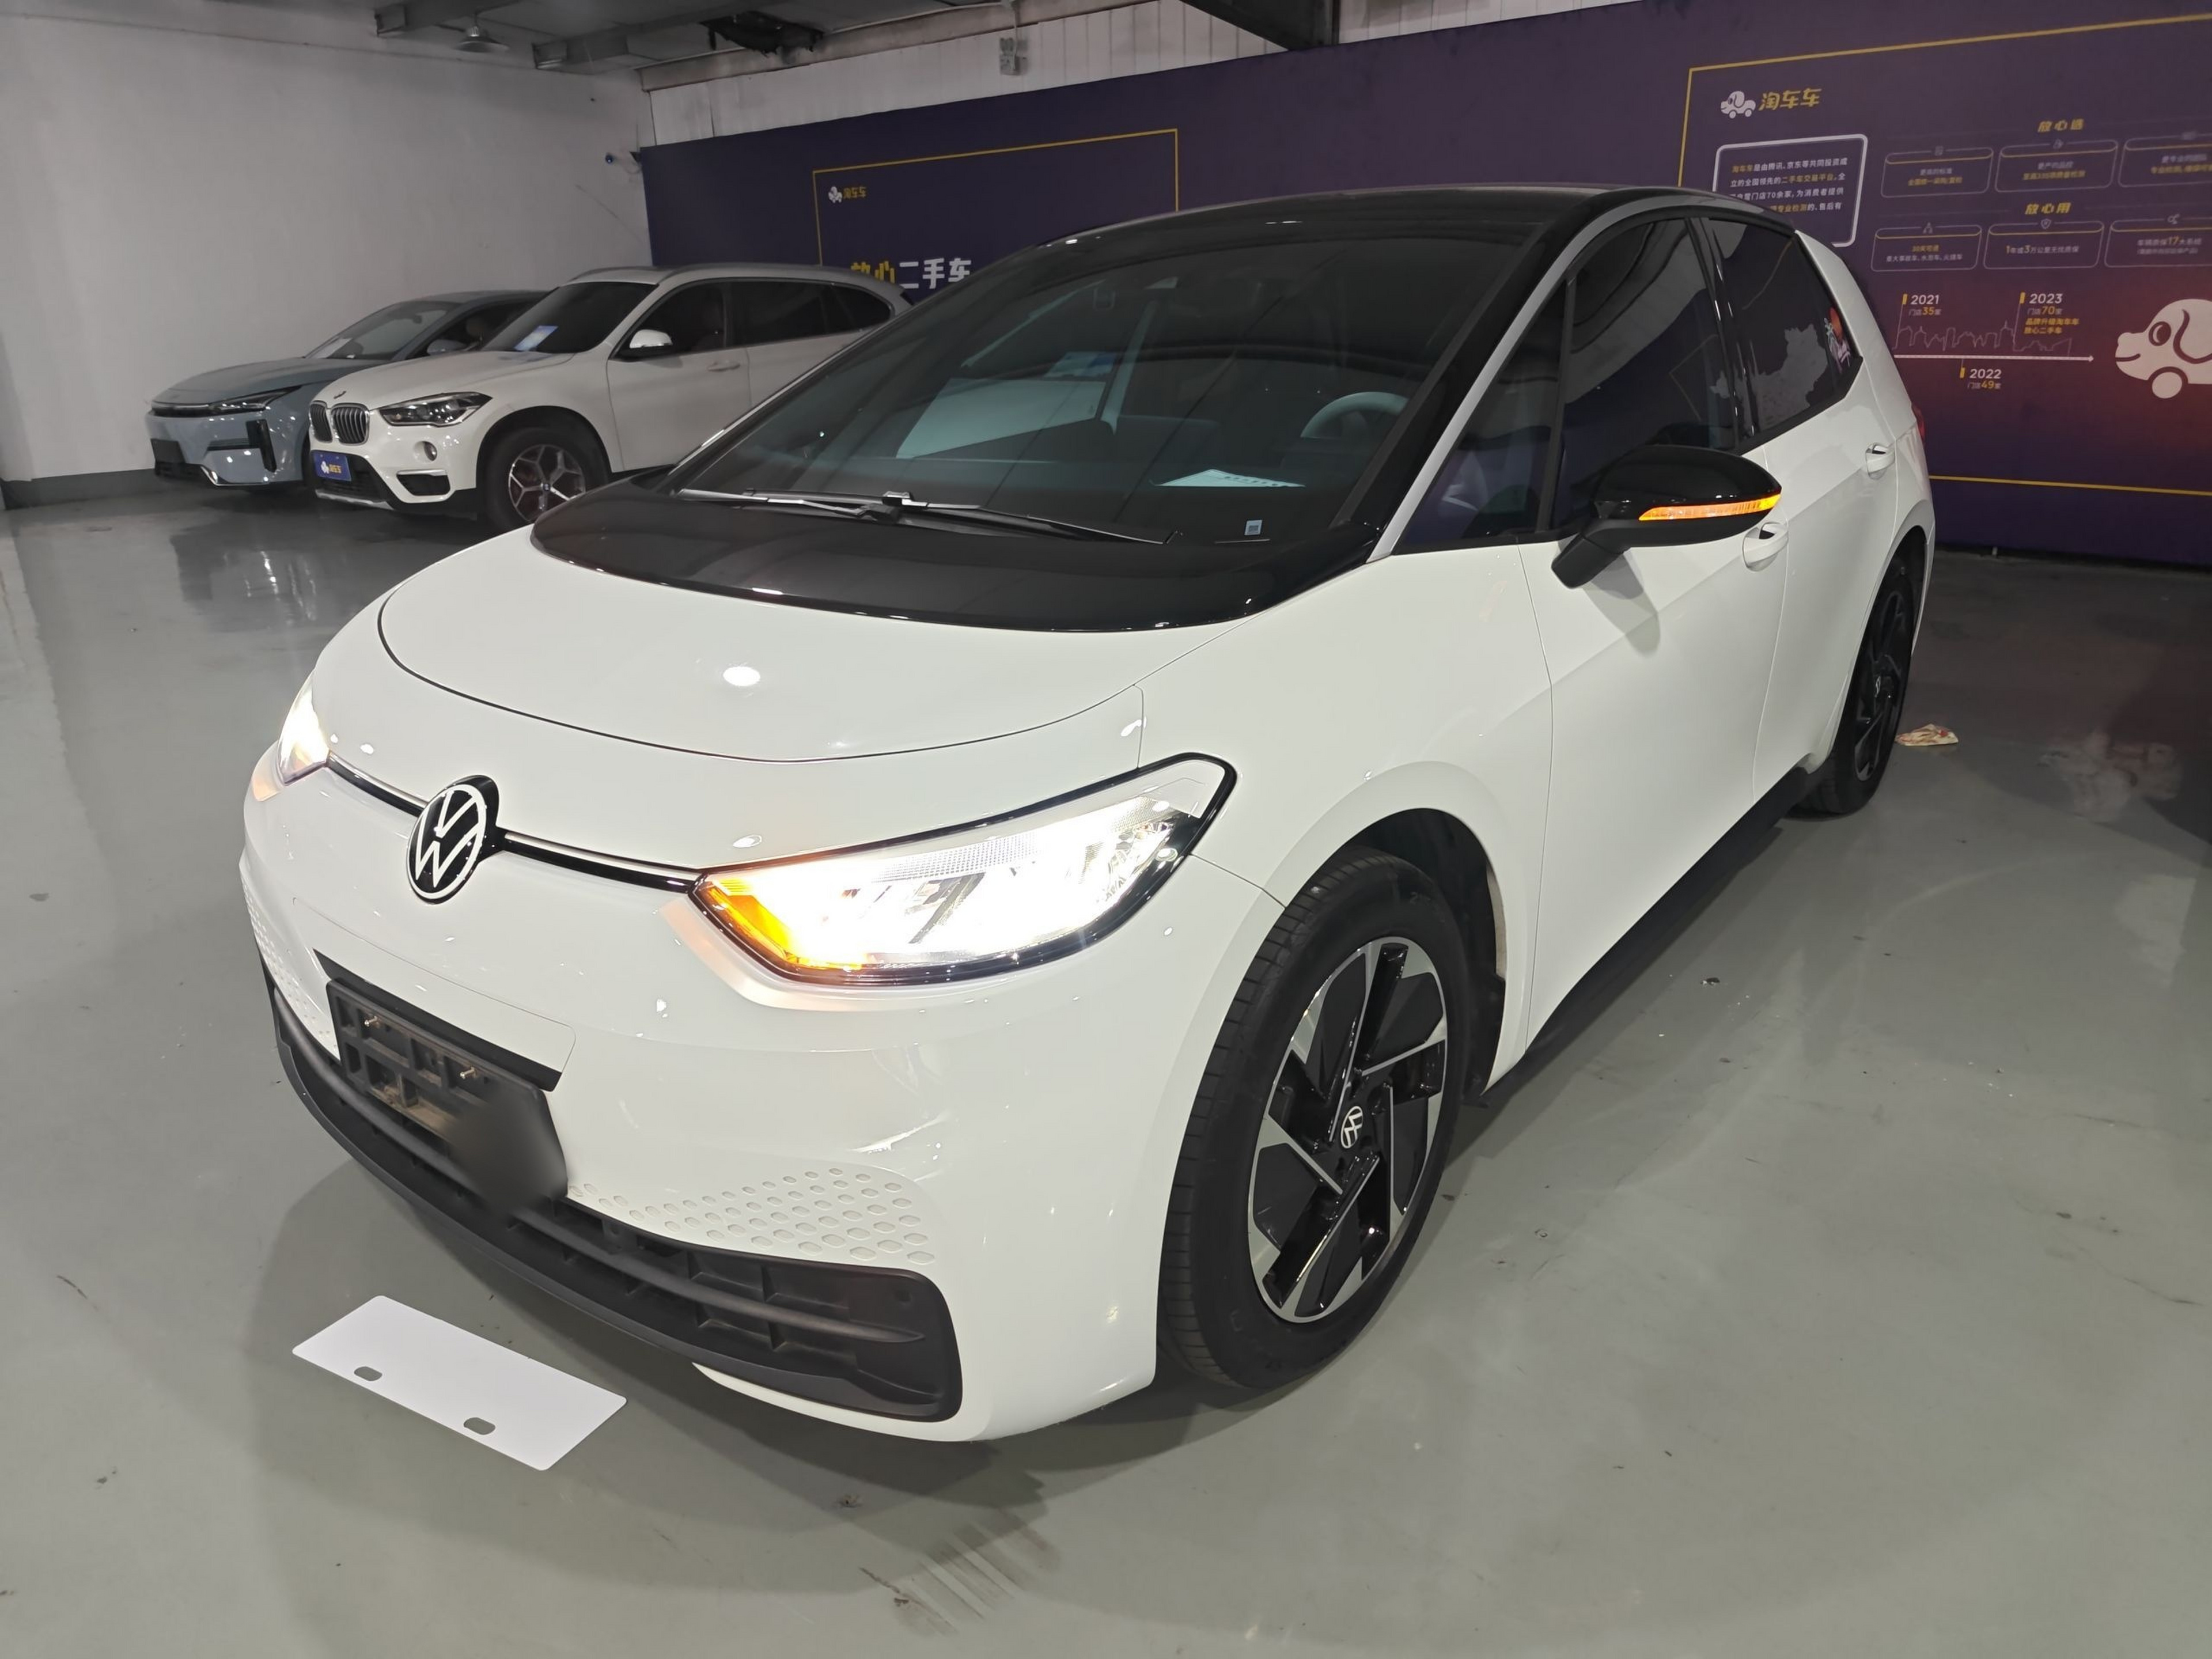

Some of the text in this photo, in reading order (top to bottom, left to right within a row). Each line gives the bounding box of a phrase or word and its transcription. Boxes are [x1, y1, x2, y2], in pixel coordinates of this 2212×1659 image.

[1758, 88, 1822, 111] 淘车车
[1910, 294, 1940, 305] 2021
[2029, 293, 2063, 304] 2023
[1969, 368, 2002, 379] 2022
